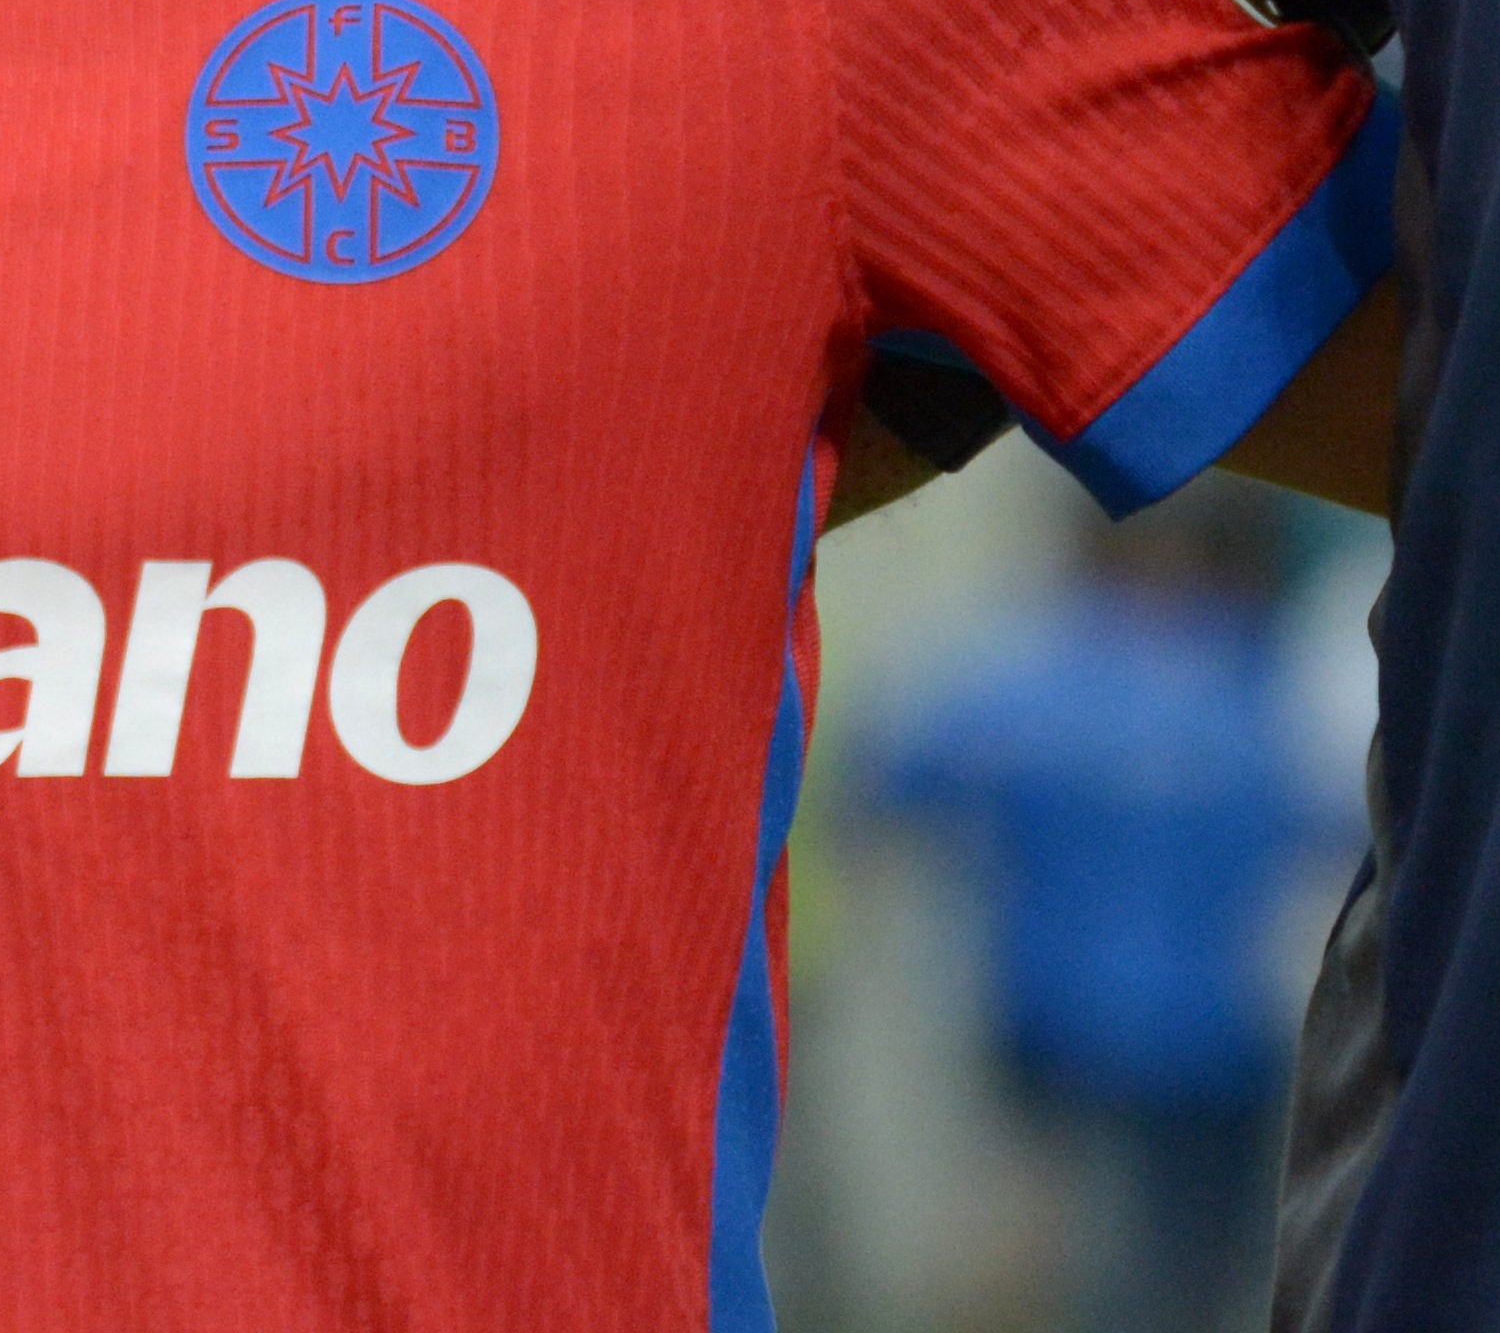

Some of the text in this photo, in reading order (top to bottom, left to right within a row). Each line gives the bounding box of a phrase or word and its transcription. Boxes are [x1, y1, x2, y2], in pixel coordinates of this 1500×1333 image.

[204, 119, 477, 153] S B
[325, 230, 355, 265] C
